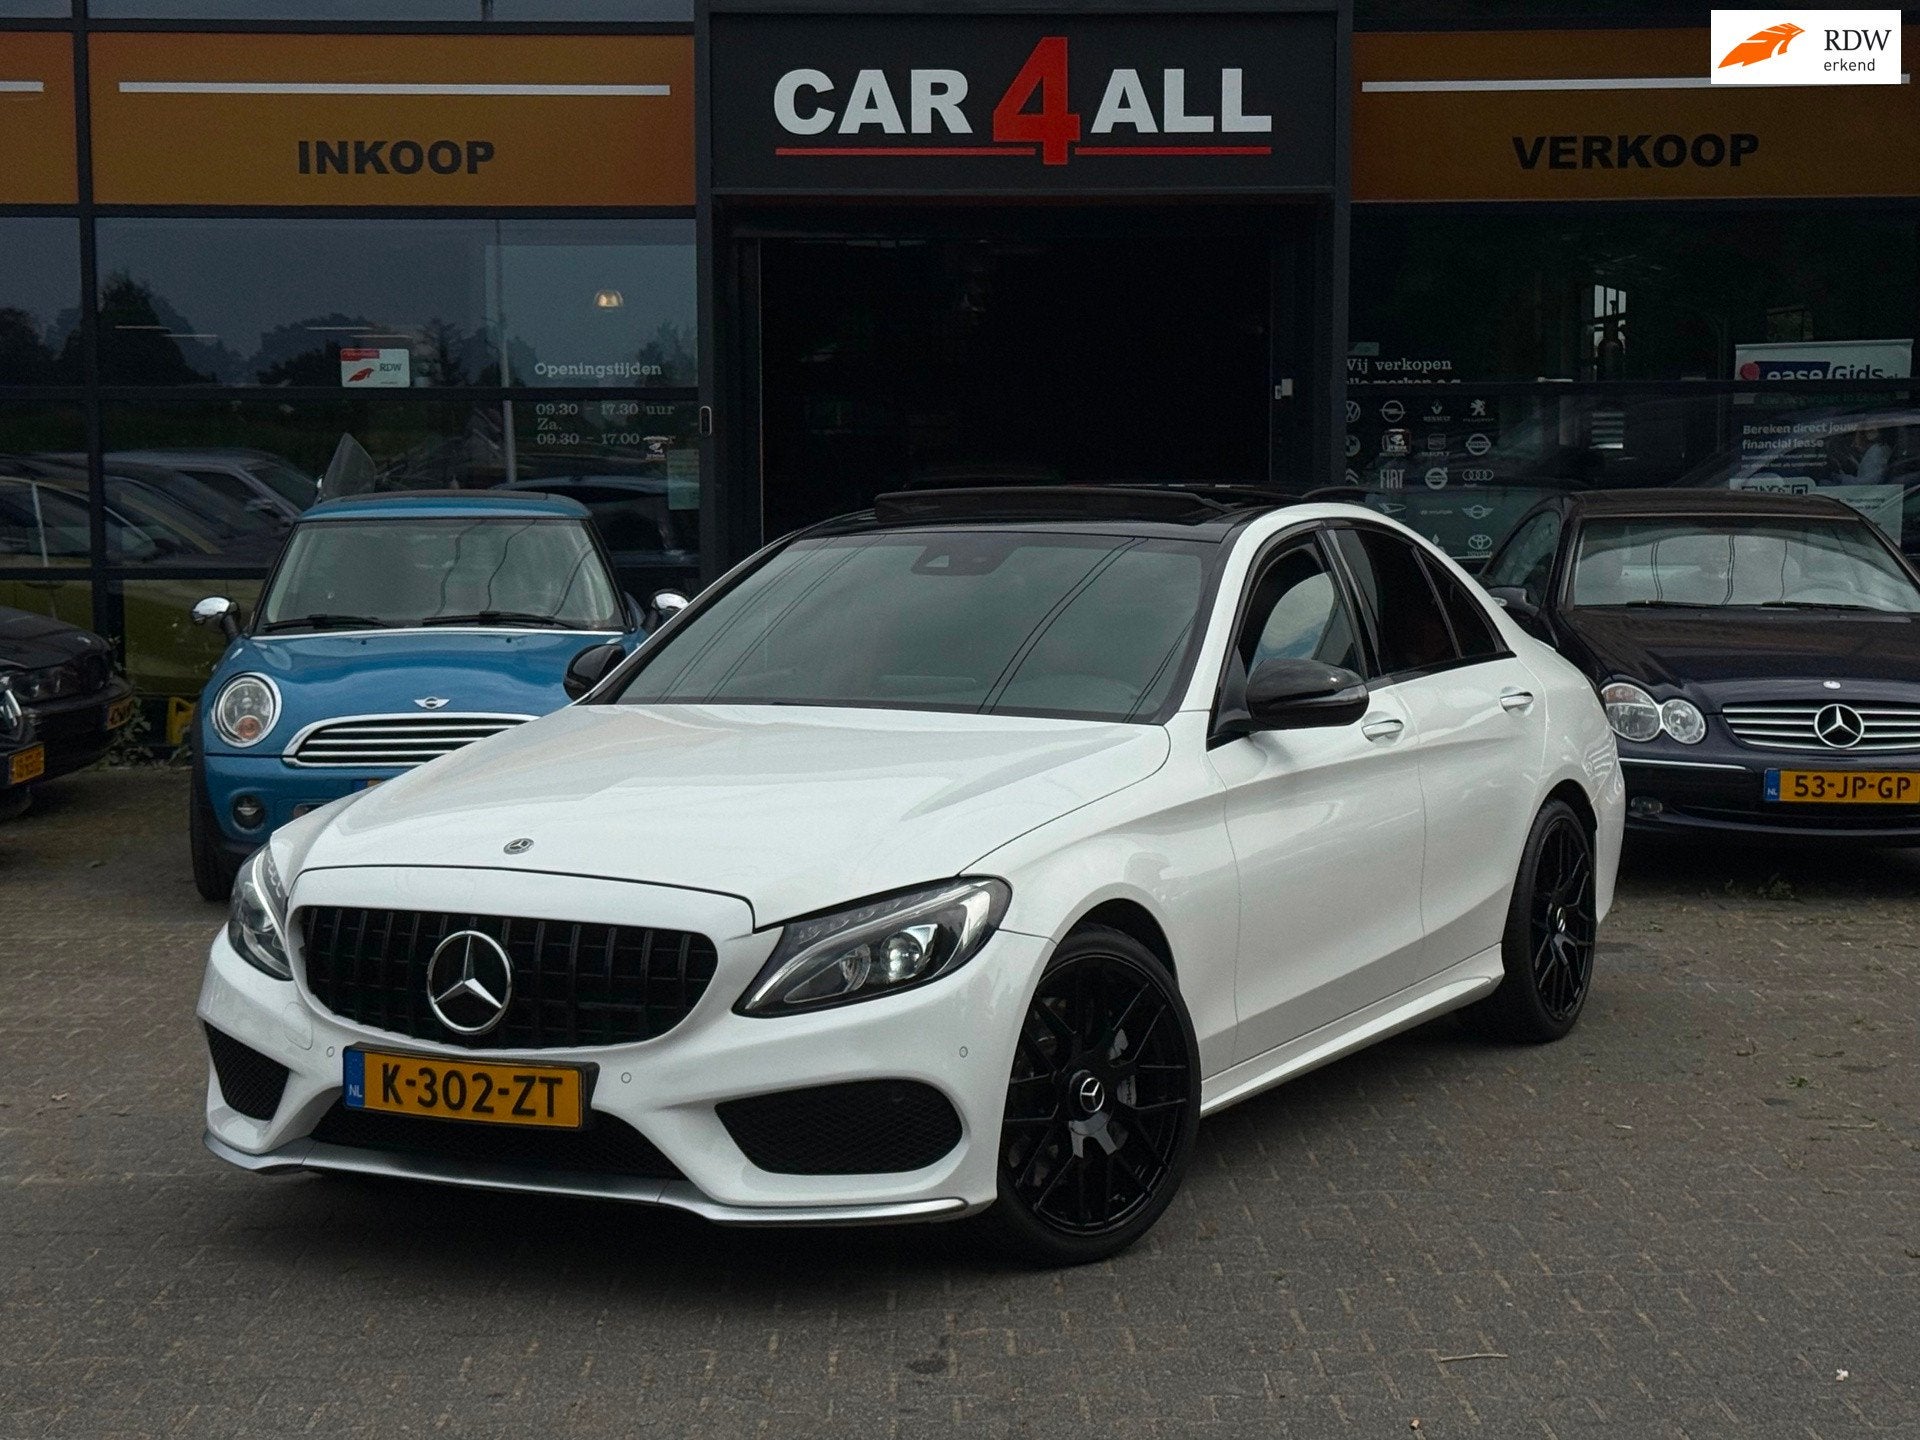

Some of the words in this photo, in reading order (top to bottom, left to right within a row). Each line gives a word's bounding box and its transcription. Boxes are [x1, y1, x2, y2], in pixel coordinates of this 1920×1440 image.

[298, 140, 496, 175] INKOOP
[1512, 133, 1760, 170] VERKOOP
[380, 363, 402, 372] RDW
[534, 362, 663, 378] Openingstijden
[1375, 358, 1453, 374] verkopen
[1380, 468, 1405, 489] FIAT
[1794, 774, 1911, 799] 53-JP-GP
[349, 1084, 363, 1098] NL
[381, 1062, 563, 1118] K-302-ZT
